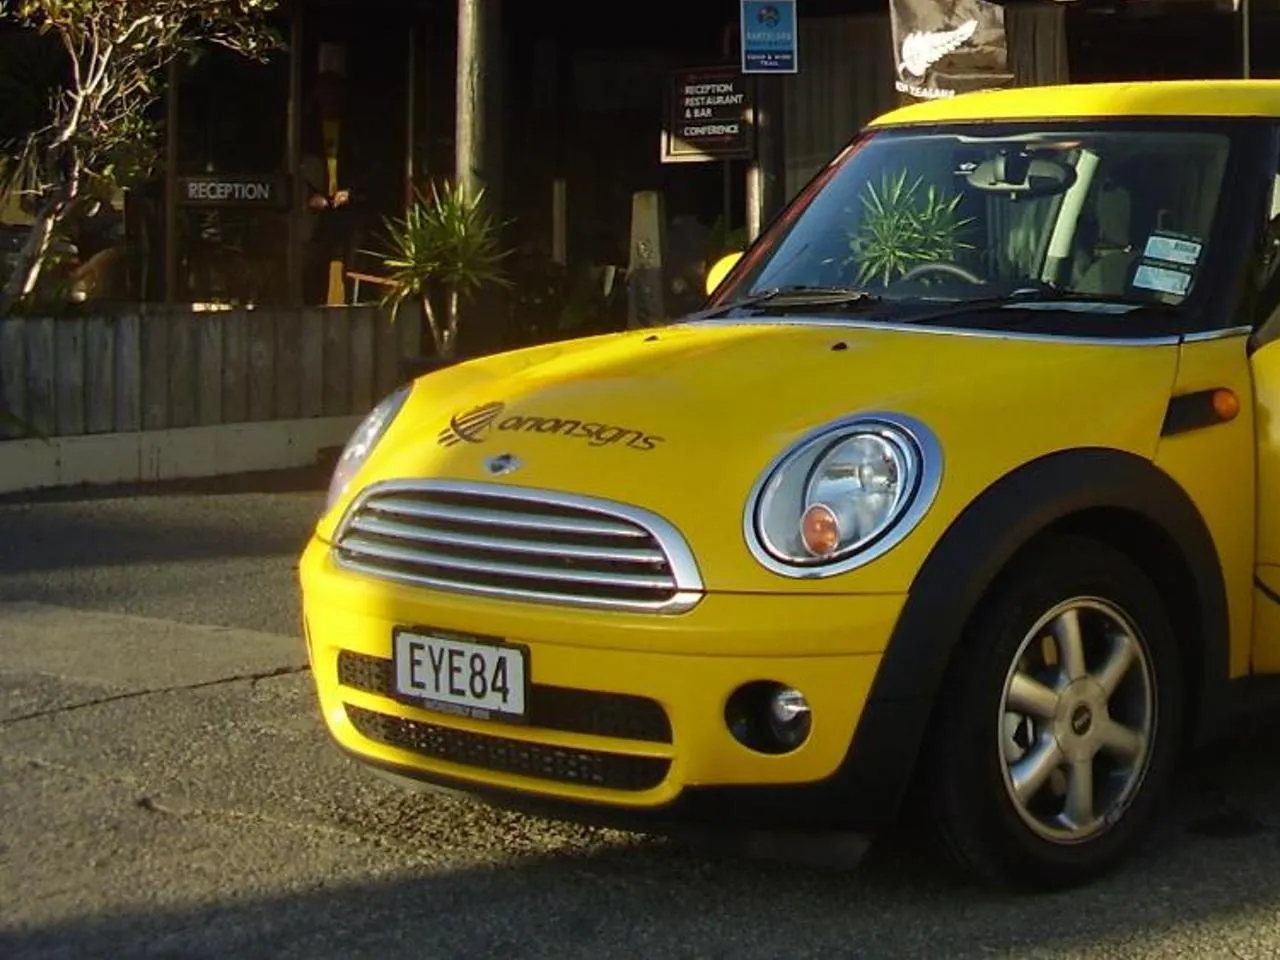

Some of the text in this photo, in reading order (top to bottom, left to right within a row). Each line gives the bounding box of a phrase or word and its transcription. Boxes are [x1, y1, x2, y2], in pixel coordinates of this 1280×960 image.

[684, 83, 734, 95] RECEPTION
[684, 94, 744, 107] RESTAURANT
[693, 107, 713, 118] BAR
[683, 125, 739, 136] CONFERENCE
[188, 183, 270, 199] RECEPTION
[498, 415, 665, 451] orionsigns
[409, 642, 510, 703] EYE84
